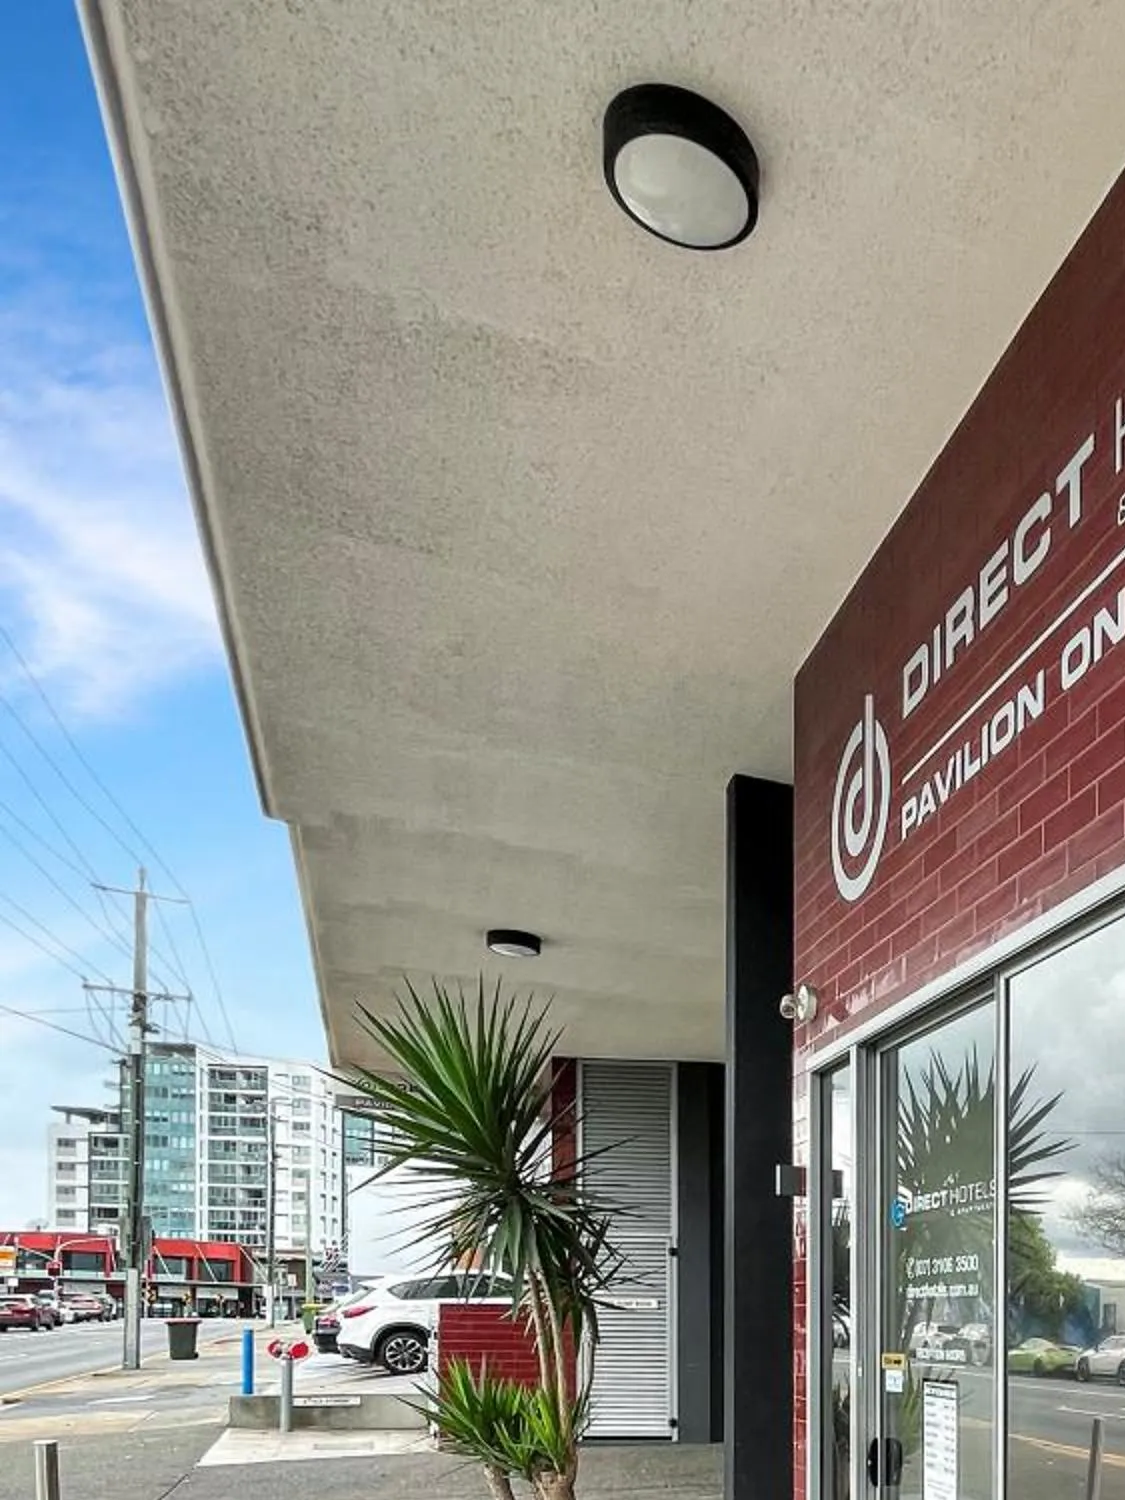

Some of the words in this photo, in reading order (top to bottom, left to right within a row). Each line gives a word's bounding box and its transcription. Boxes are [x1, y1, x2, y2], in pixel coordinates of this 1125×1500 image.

[902, 433, 1095, 720] DIRECT
[901, 669, 1045, 842] PAVILION
[954, 1253, 979, 1272] 3500
